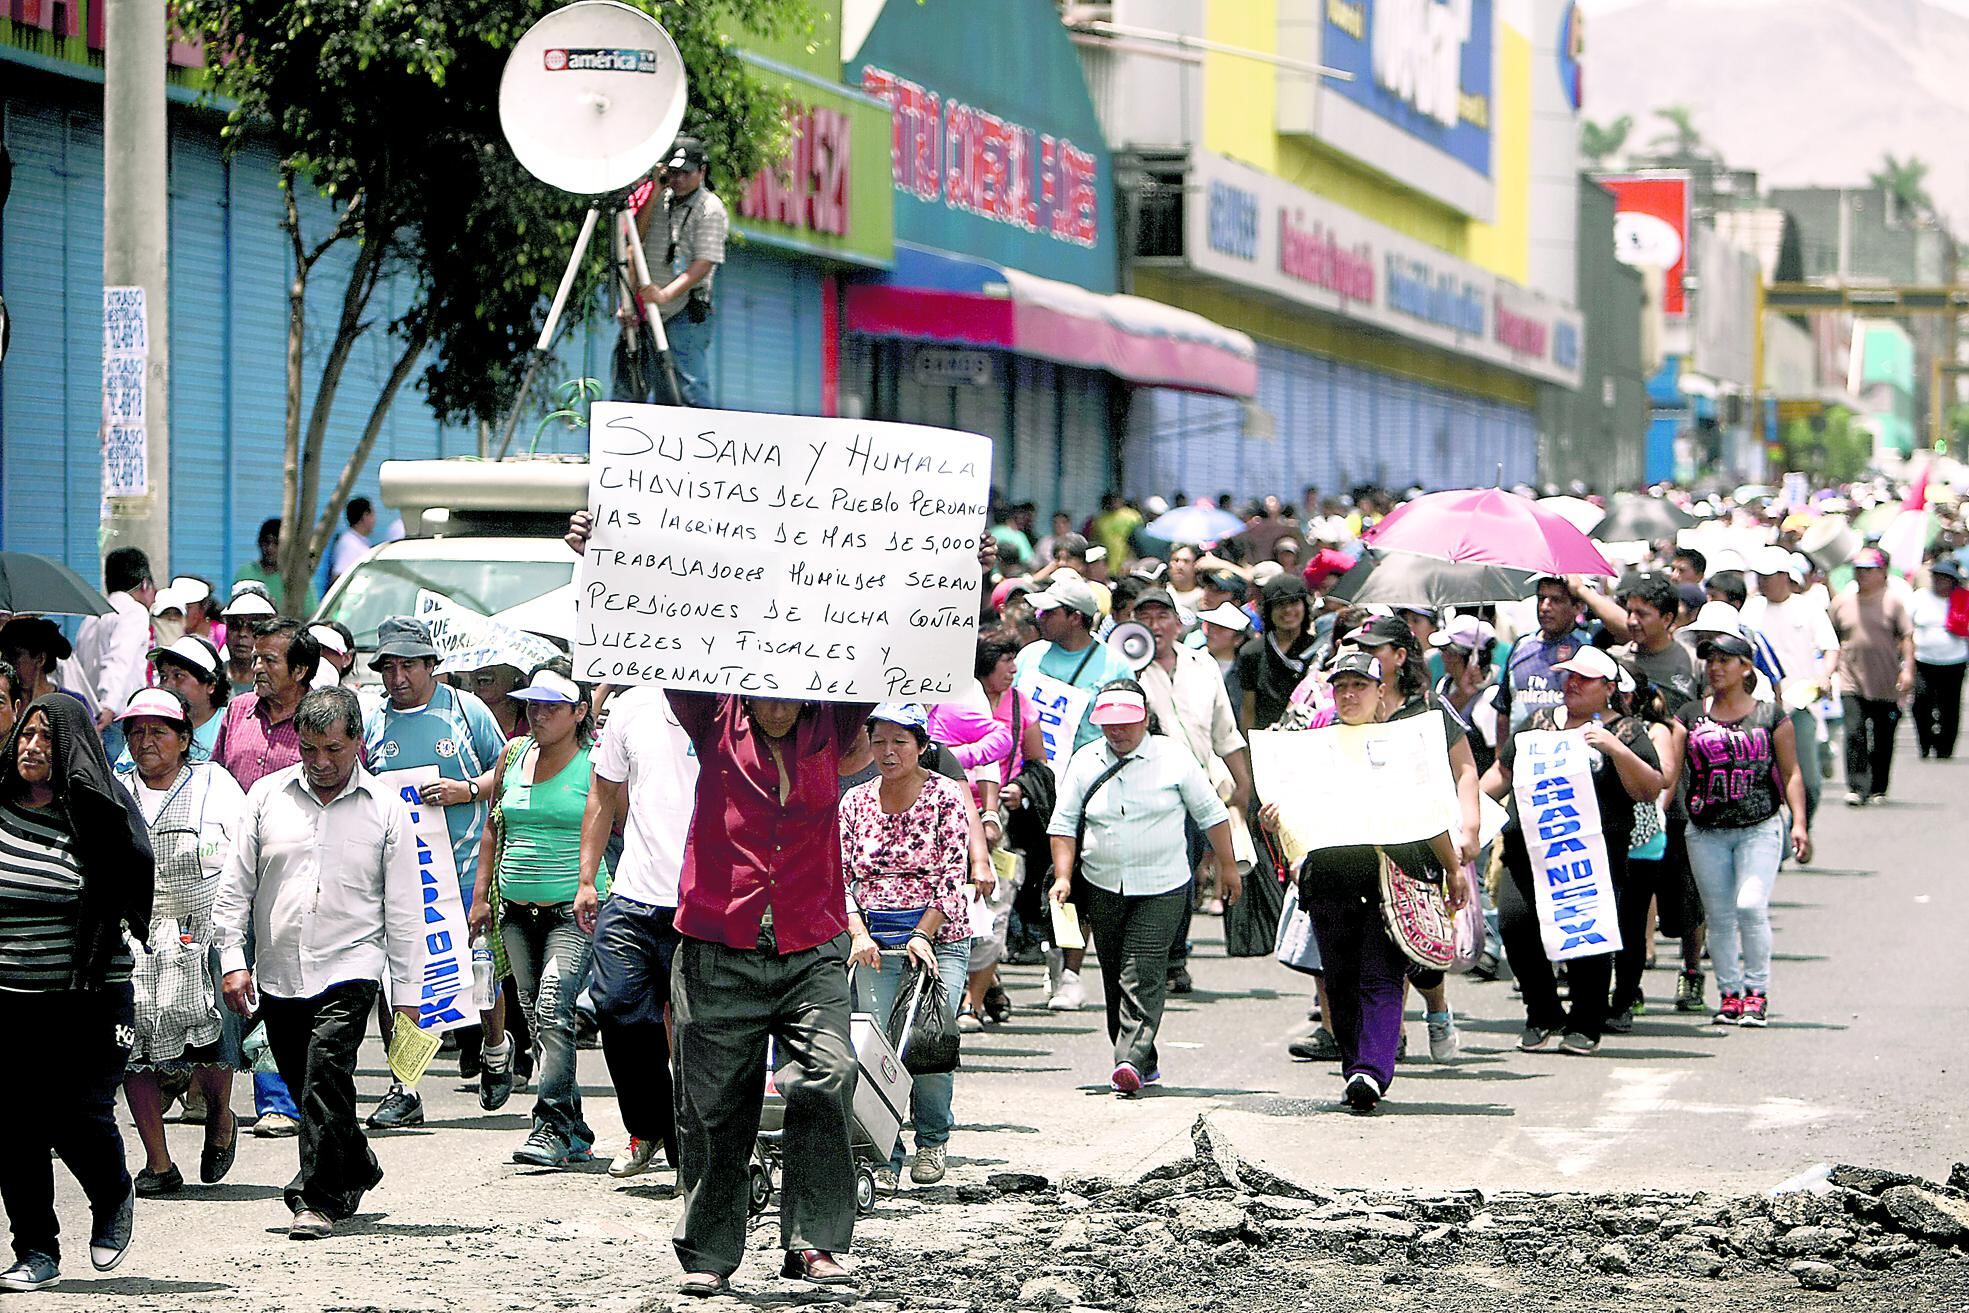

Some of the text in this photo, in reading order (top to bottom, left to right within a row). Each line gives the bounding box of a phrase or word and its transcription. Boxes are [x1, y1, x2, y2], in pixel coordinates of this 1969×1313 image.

[568, 51, 637, 70] américa
[602, 415, 975, 487] SUSANA Y HUMALA
[767, 484, 820, 510] DEL
[908, 489, 986, 517] PERUANO
[773, 521, 809, 546] DE
[821, 525, 867, 549] MAS
[884, 530, 914, 552] DE
[922, 535, 975, 556] 5,000
[589, 548, 765, 582] TRABAJADORES
[904, 571, 977, 592] SERAN
[762, 600, 802, 623] DE
[909, 606, 974, 629] CONTRA
[577, 623, 682, 650] JUEZES
[700, 635, 715, 656] Y
[880, 646, 891, 666] Y
[586, 657, 952, 697] GOBERNANTES DEL PERÚ
[1032, 686, 1068, 714] LA
[1529, 740, 1571, 756] LA
[1532, 758, 1587, 860] PARADA
